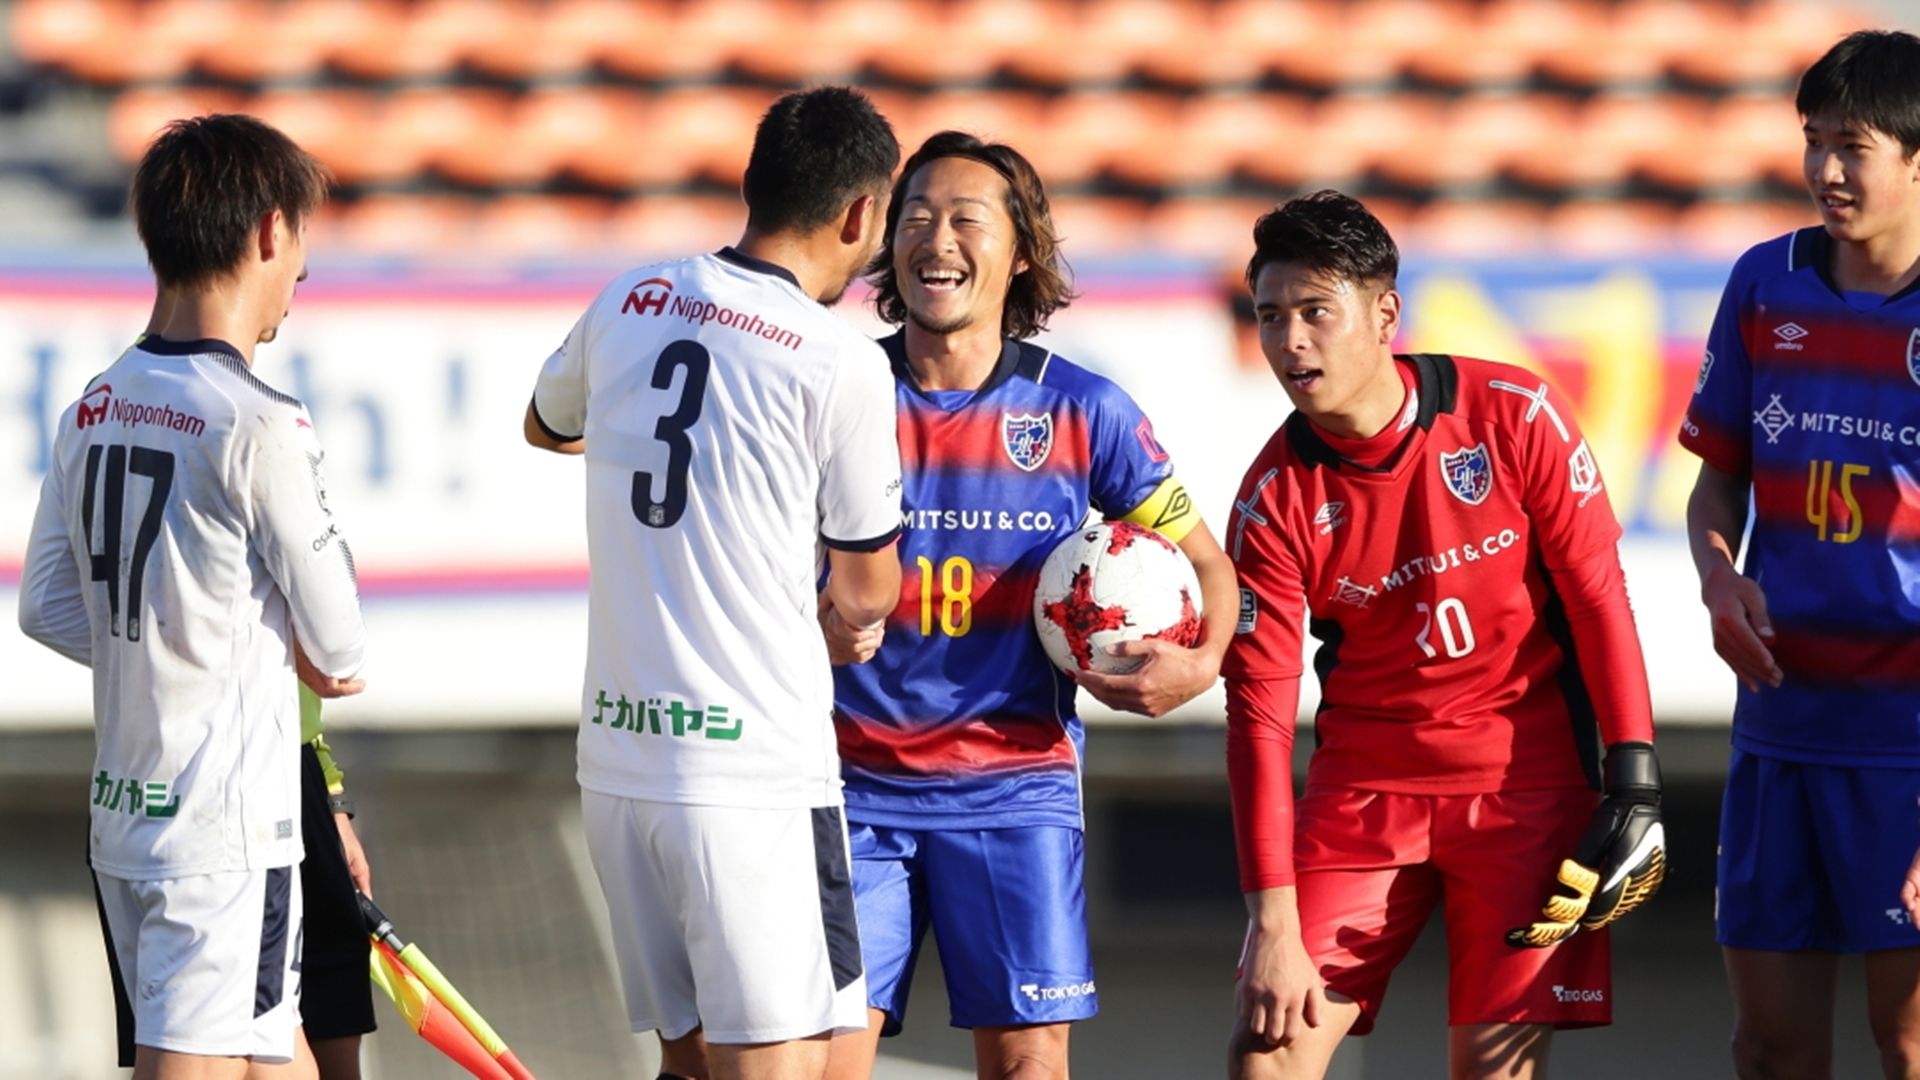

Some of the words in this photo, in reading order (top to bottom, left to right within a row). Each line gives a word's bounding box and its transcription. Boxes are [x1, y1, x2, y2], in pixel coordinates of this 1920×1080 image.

[669, 295, 802, 350] Nipponham
[111, 398, 206, 437] Nipponham
[631, 339, 711, 529] 3
[1801, 412, 1880, 439] MITSUI
[1881, 422, 1896, 442] &
[900, 510, 993, 530] MITSUI
[997, 510, 1014, 530] &
[1018, 511, 1056, 531] CO.
[1806, 459, 1871, 544] 45
[82, 444, 175, 642] 47
[1380, 547, 1461, 592] MITUI
[1463, 543, 1481, 562] &
[1482, 529, 1520, 555] CO.
[917, 556, 973, 637] 18
